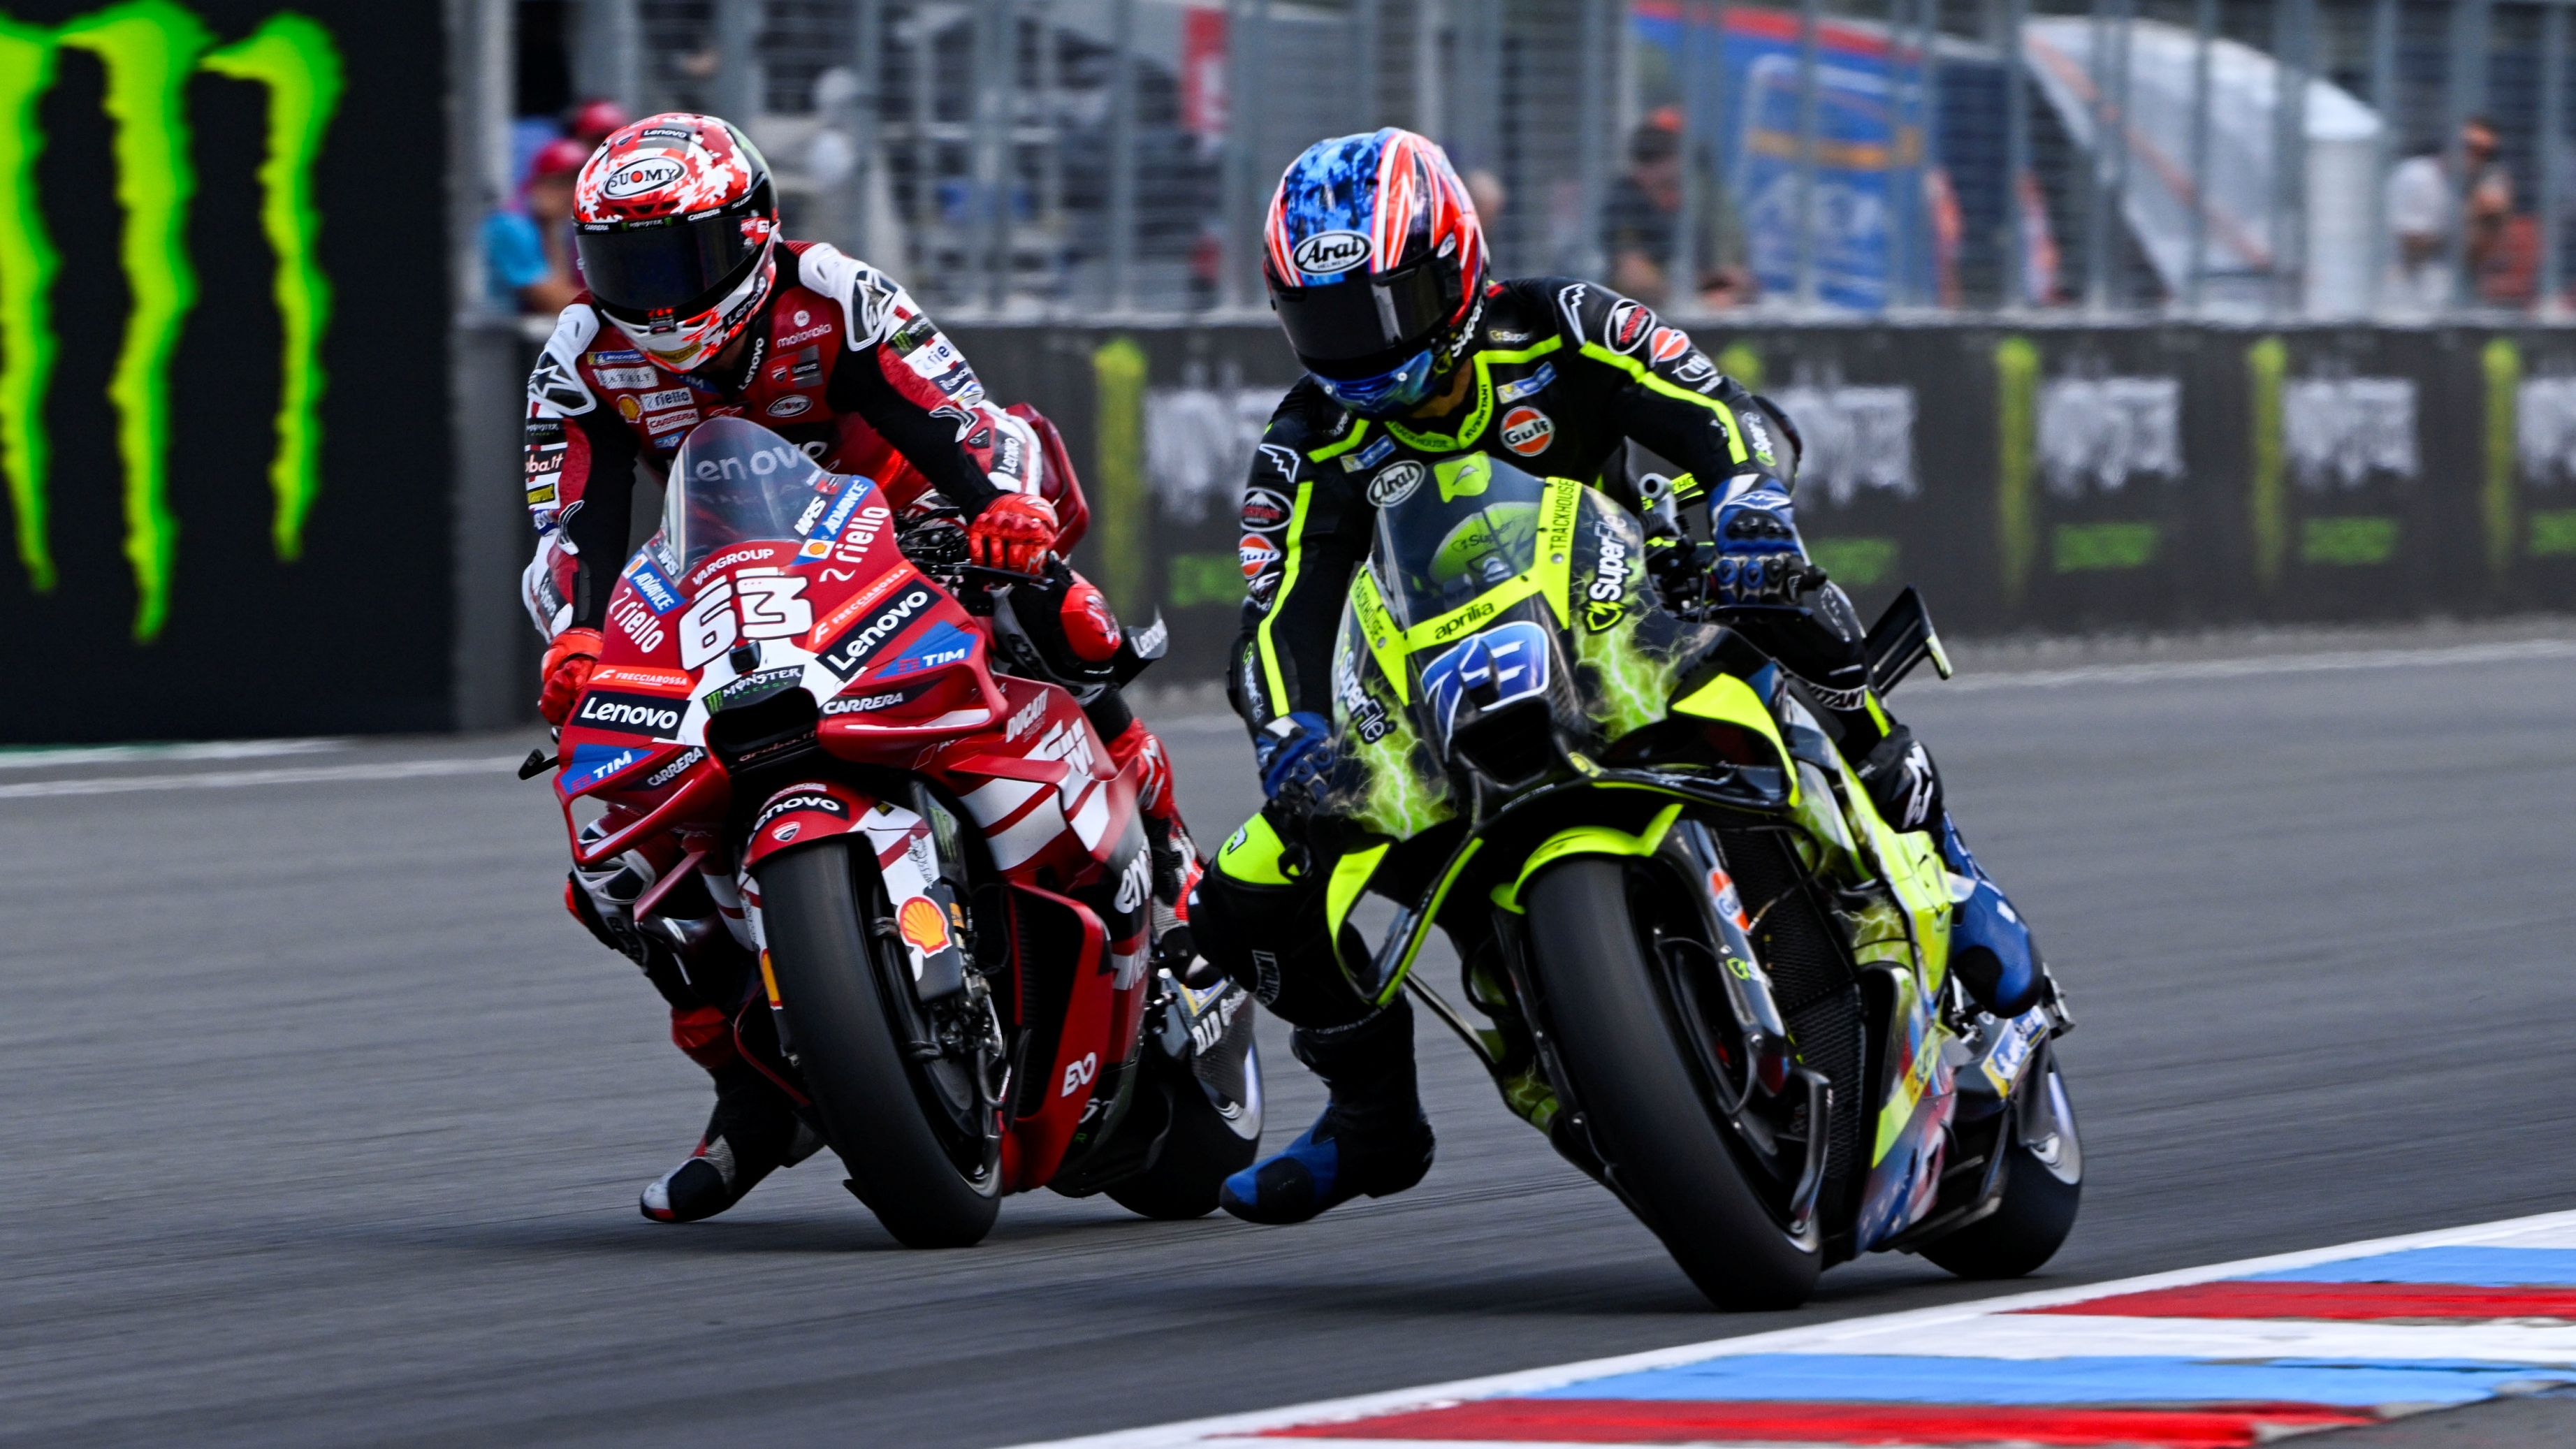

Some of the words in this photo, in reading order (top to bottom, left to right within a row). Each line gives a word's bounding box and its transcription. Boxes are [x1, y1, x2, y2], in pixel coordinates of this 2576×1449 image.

[643, 129, 687, 138] Lenovo
[610, 168, 676, 187] SUOMY
[687, 209, 721, 222] CARRERA
[1297, 237, 1360, 263] Arai
[727, 277, 766, 326] Lenovo
[777, 323, 832, 348] motorola
[738, 337, 765, 390] Lenovo
[655, 391, 690, 407] riello
[649, 412, 697, 428] CARRERA
[1504, 418, 1550, 444] Gulf
[525, 453, 564, 473] ba.it
[794, 497, 826, 536] WRS
[822, 481, 868, 534] ADVANCE
[1550, 478, 1576, 551] TRACKHOUSE
[836, 507, 889, 563] riello
[692, 548, 774, 585] VARGROUP
[633, 571, 674, 610] ADVANCE
[832, 569, 908, 625] FRECCIAROSSA
[613, 601, 664, 653] riello
[680, 567, 813, 671] 63
[827, 592, 928, 671] Lenovo
[1435, 602, 1494, 640] aprilia
[922, 648, 966, 666] TIM
[615, 672, 688, 686] FRECCIAROSSA
[722, 668, 801, 697] MONSTER
[1339, 650, 1385, 741] SuperFile
[581, 697, 678, 729] Lenovo
[823, 693, 903, 714] CARRERA
[1005, 688, 1048, 743] DUCATI
[593, 750, 632, 778] TIM
[647, 747, 704, 786] CARRERA
